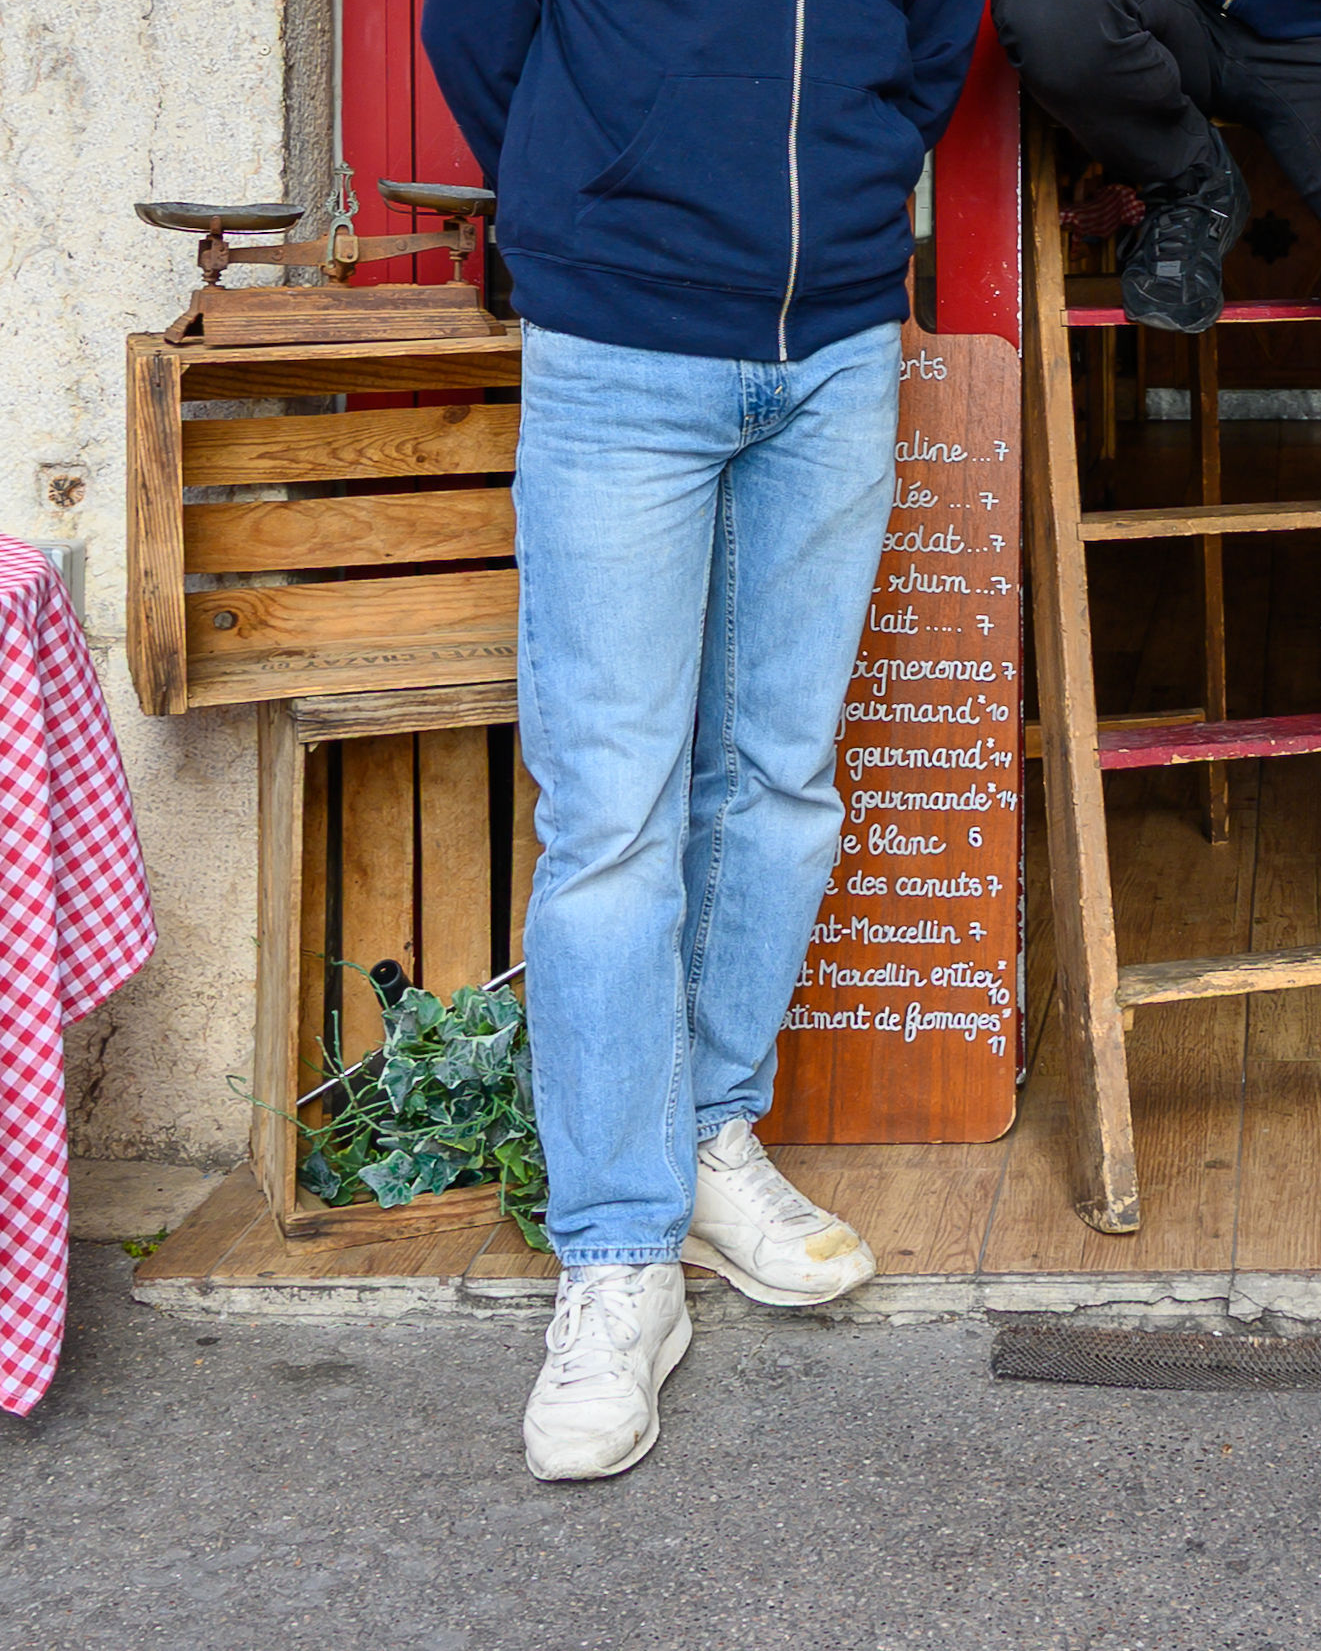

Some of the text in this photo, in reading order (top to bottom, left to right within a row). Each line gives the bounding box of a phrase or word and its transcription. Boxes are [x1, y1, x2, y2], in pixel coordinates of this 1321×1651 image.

[900, 349, 948, 381] erts
[895, 430, 1010, 463] aline 7
[892, 477, 1000, 511] lée 7
[881, 524, 1006, 554] ocolat 7
[887, 563, 1012, 595] rhum 7
[870, 604, 995, 636] lait 7
[1001, 661, 1018, 681] 7
[985, 702, 1009, 722] 10
[989, 750, 1013, 769] 14
[996, 790, 1018, 812] 14
[868, 823, 947, 856] blanc
[846, 870, 889, 896] des
[895, 871, 983, 898] canuts
[986, 874, 1003, 898] 7
[810, 914, 988, 945] nt-Marcellin 7
[818, 959, 928, 988] Marcellin
[987, 987, 1010, 1005] 10
[780, 1004, 872, 1031] rtiment
[874, 1006, 902, 1032] de
[987, 1035, 1007, 1057] 11
